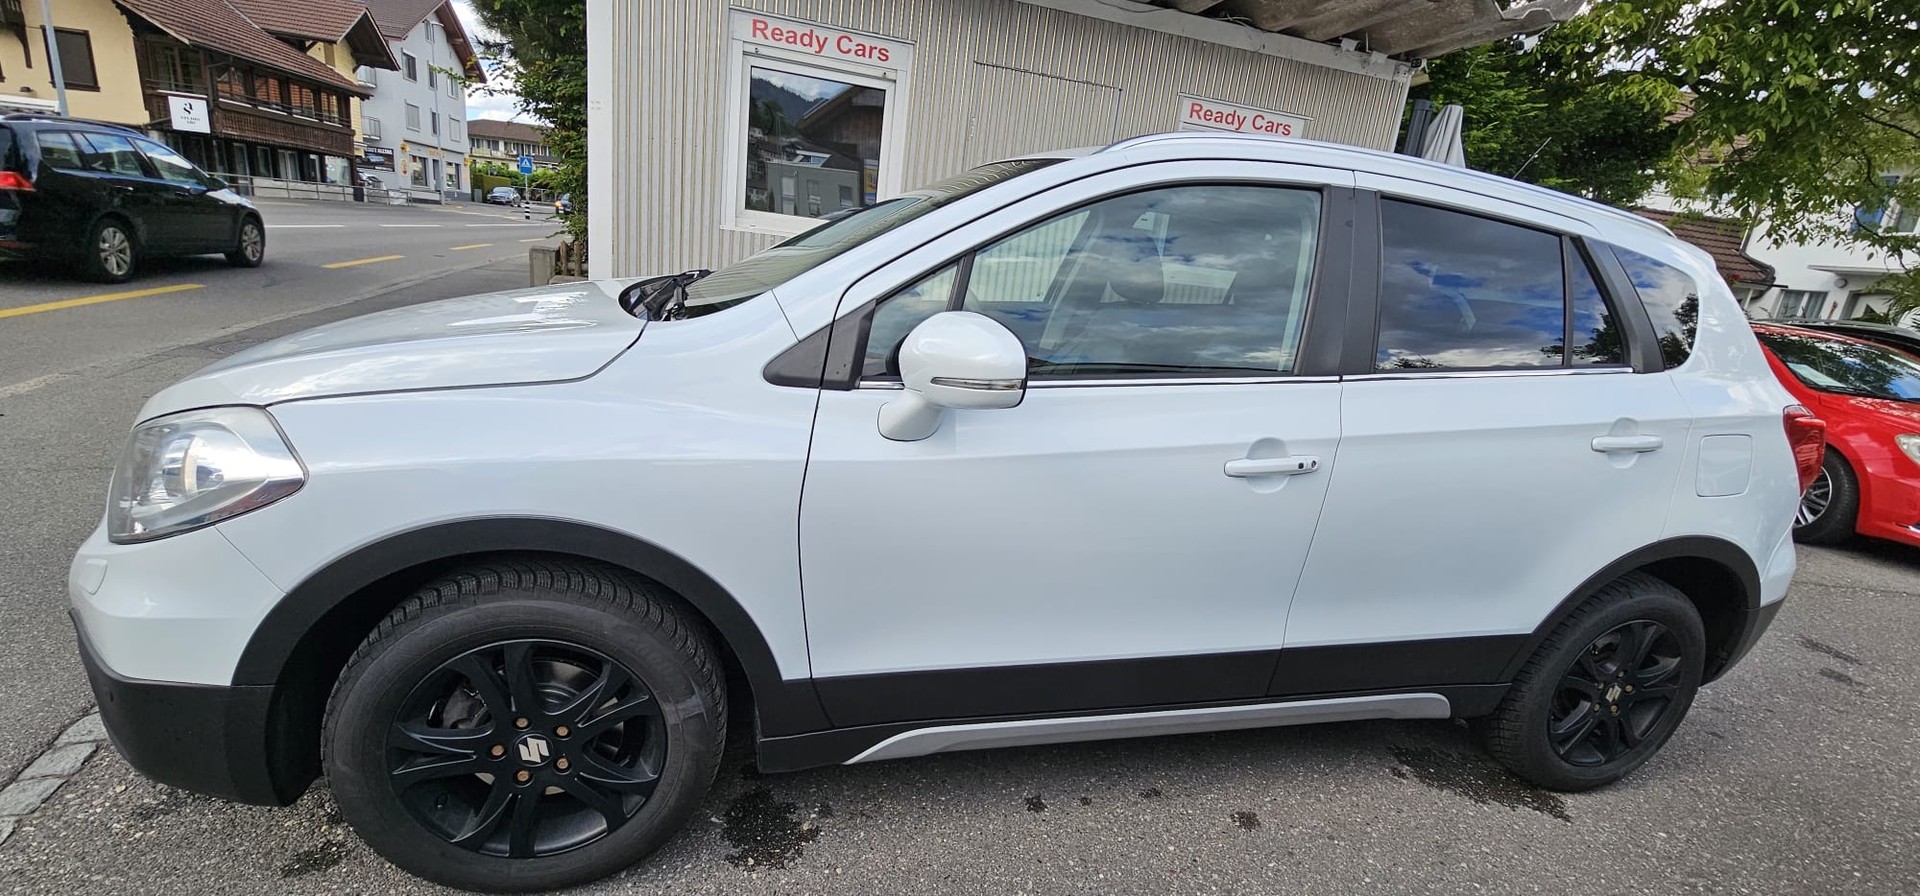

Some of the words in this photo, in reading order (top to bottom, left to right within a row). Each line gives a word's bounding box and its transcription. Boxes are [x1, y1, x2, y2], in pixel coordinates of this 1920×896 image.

[751, 18, 828, 55] Ready
[836, 34, 890, 62] Cars
[1189, 102, 1246, 130] Ready
[1252, 114, 1291, 136] Cars
